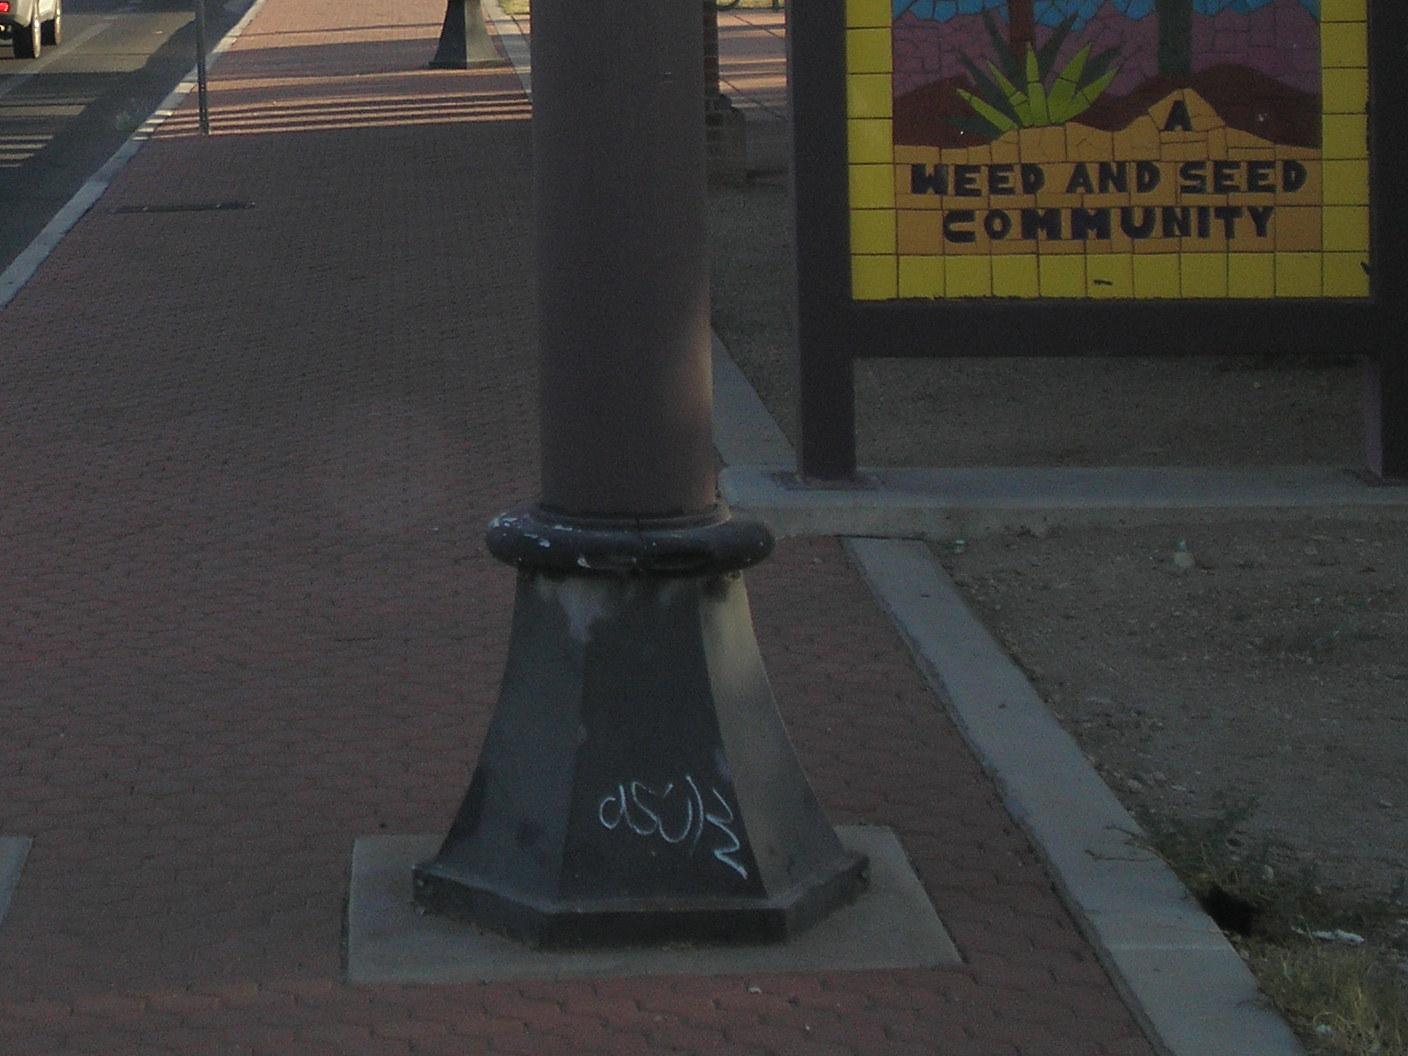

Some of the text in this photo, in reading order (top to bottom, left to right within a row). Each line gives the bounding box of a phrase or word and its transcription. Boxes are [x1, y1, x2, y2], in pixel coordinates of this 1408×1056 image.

[1165, 100, 1193, 131] A
[910, 159, 1308, 196] WEED AND SEED
[942, 206, 1275, 243] COMMUNITY
